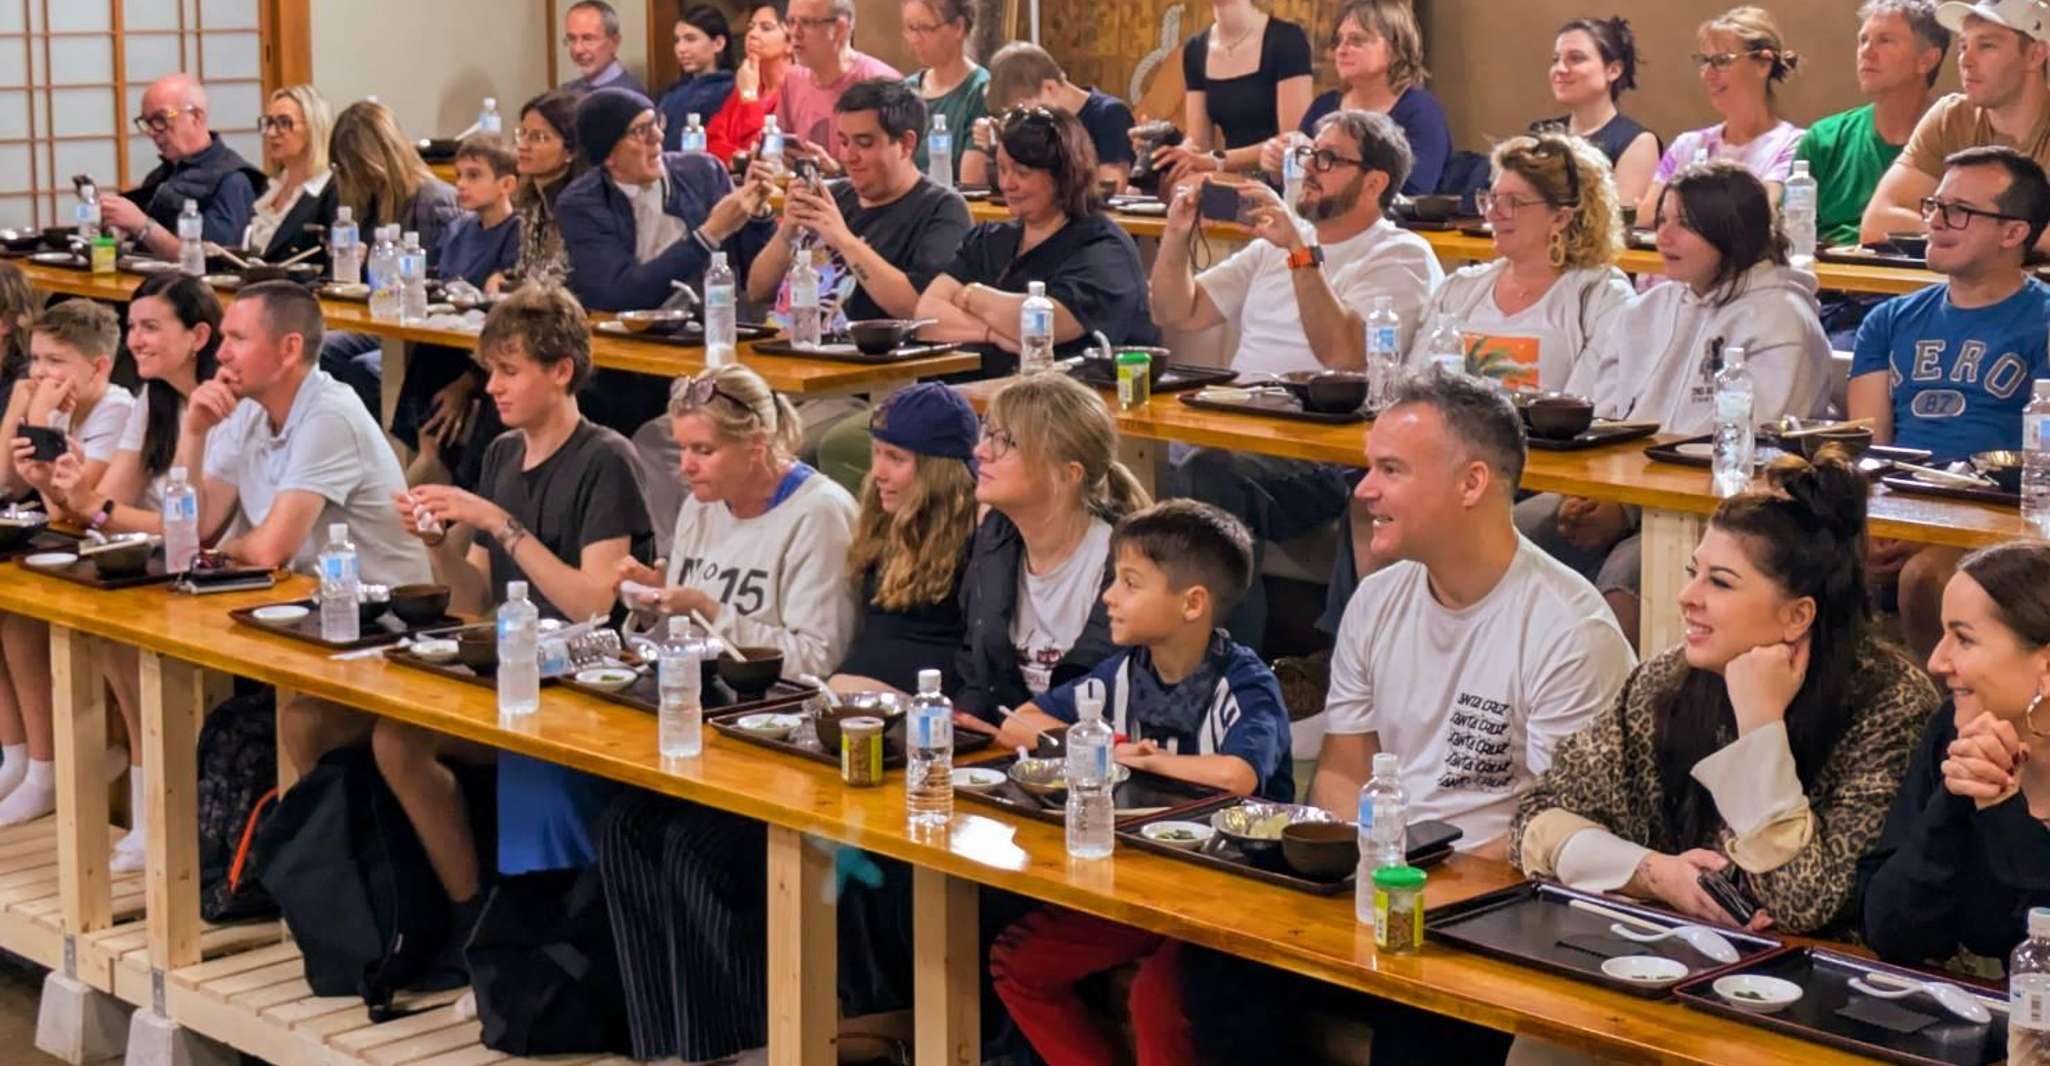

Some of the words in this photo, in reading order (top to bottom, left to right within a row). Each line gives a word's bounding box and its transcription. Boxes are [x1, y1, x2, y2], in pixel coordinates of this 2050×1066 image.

[1925, 394, 1952, 412] 87
[1481, 699, 1510, 716] CRUZ
[1478, 719, 1510, 735] CRUZ
[1475, 739, 1511, 755] CRUZ
[1475, 759, 1512, 773] CRUZ
